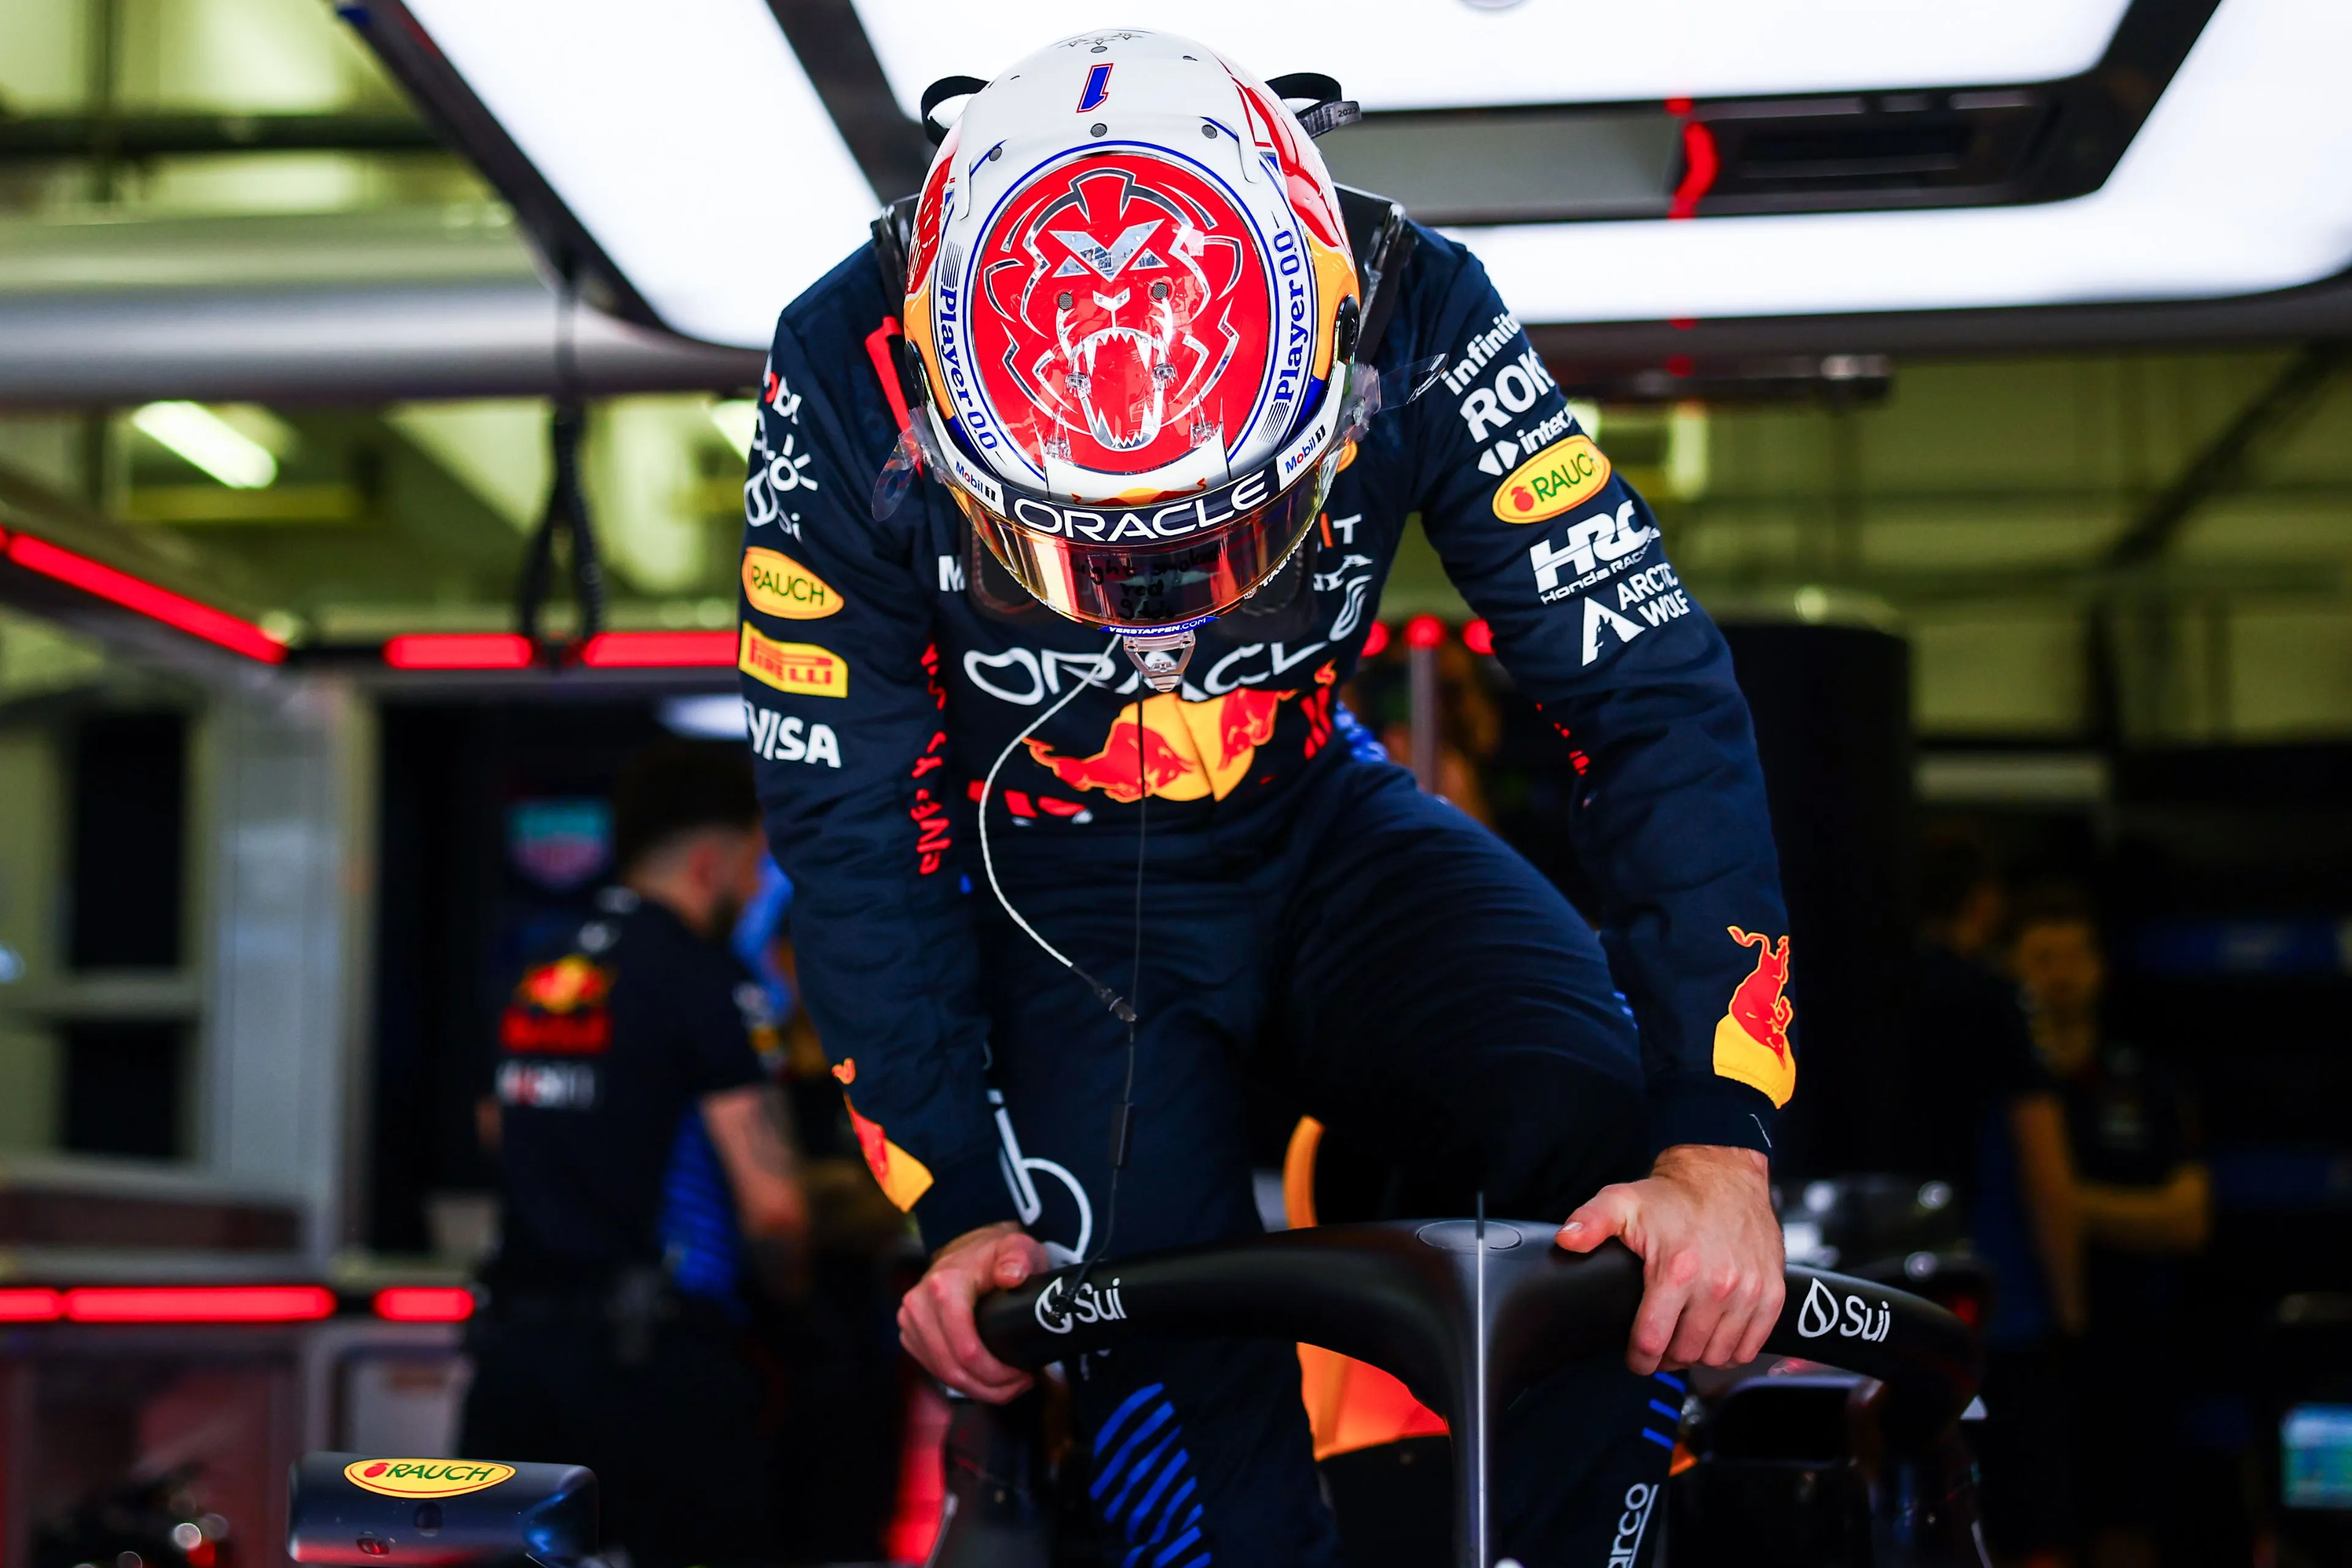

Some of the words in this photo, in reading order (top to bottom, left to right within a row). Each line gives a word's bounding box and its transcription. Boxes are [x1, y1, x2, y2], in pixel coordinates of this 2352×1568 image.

[1076, 62, 1114, 113] 1
[956, 461, 983, 493] Mobil
[1285, 436, 1316, 474] Mobil
[1014, 469, 1268, 542] ORACLE
[1529, 499, 1652, 594] HRC
[752, 565, 824, 606] RAUCH
[1540, 568, 1611, 605] Honda
[1616, 562, 1678, 611] ARCTIC
[1637, 589, 1691, 627] WOLF
[1109, 617, 1206, 635] VERSTAPPEN.COM
[749, 636, 833, 685] PIRELLI
[743, 699, 842, 769] VISA
[1074, 1277, 1127, 1323] Sui
[1839, 1295, 1891, 1343] Sui
[386, 1463, 496, 1482] RAUCH
